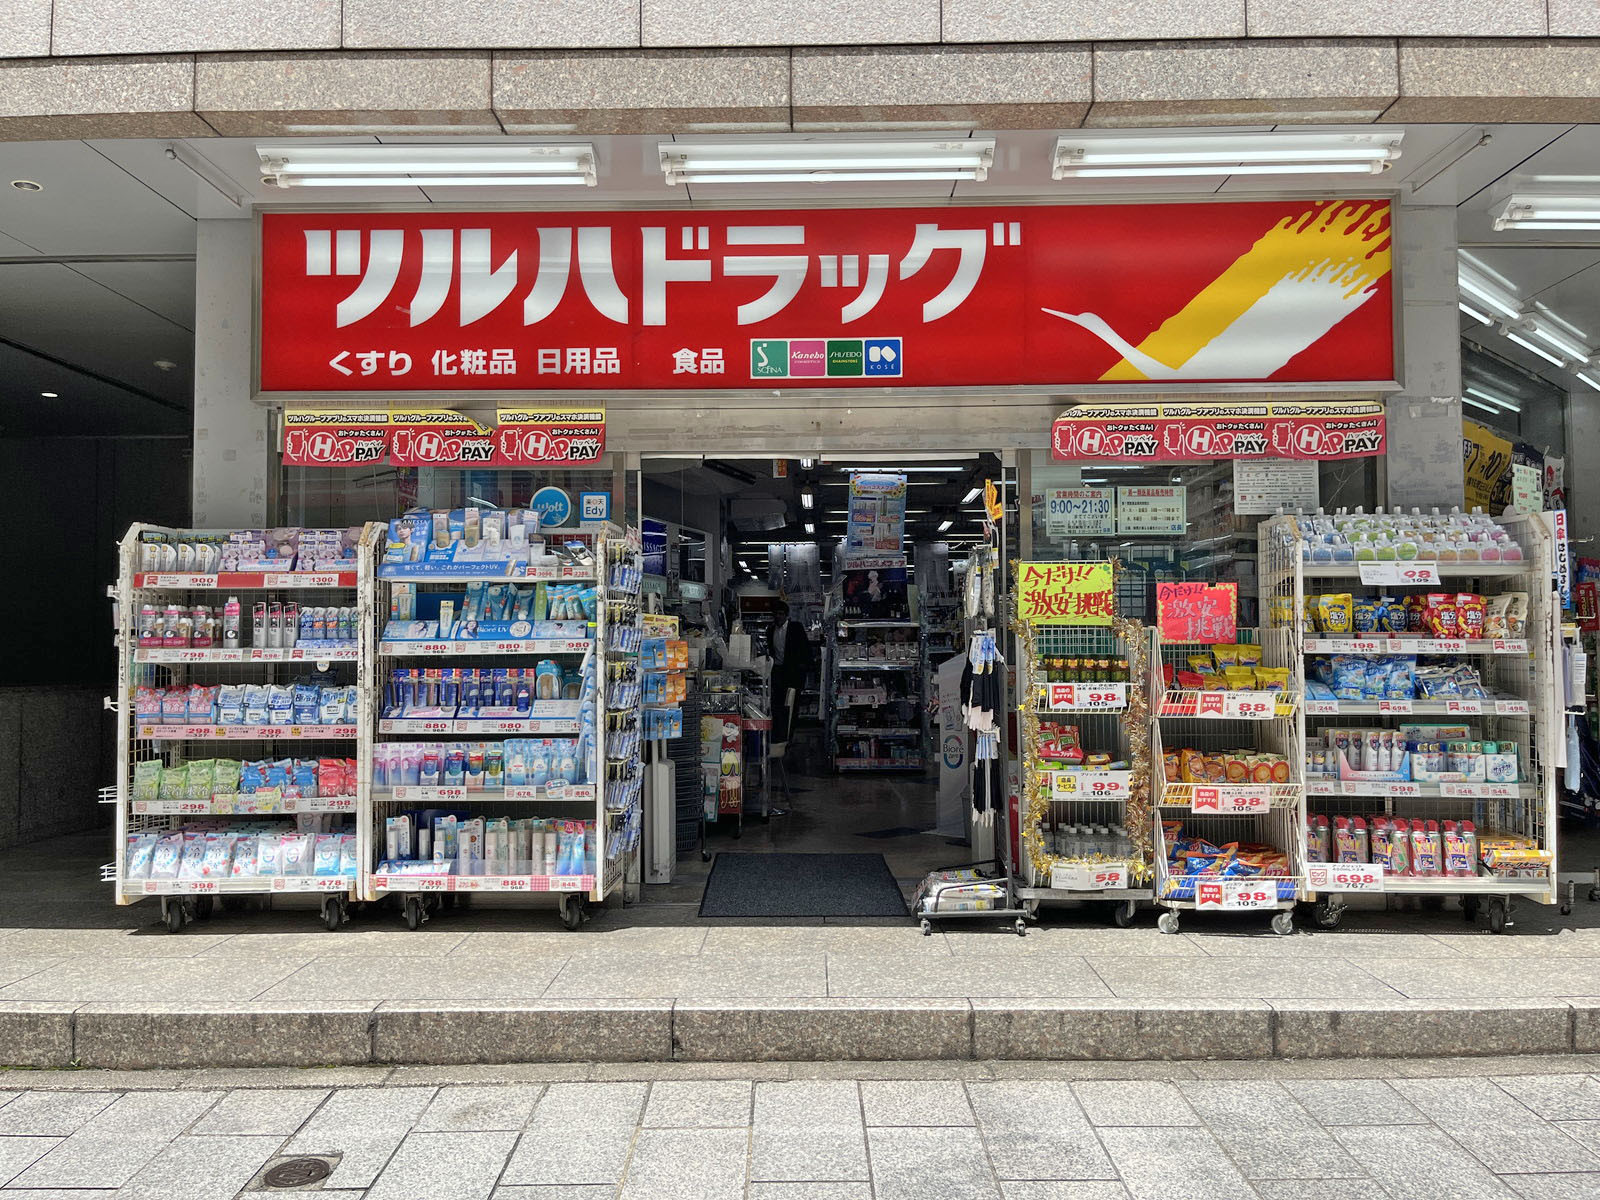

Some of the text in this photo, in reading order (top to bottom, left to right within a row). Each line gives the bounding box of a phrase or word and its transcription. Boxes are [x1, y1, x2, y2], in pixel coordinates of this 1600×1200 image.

[303, 222, 1021, 328] ツルハドラッグ
[328, 347, 725, 377] くすり 化粧品 日用品 食品
[791, 351, 825, 360] Kanebo
[1055, 489, 1103, 499] 営業時間のご案内
[586, 506, 604, 517] Edy
[1166, 595, 1217, 618] 激安
[1184, 614, 1235, 641] 挑戦
